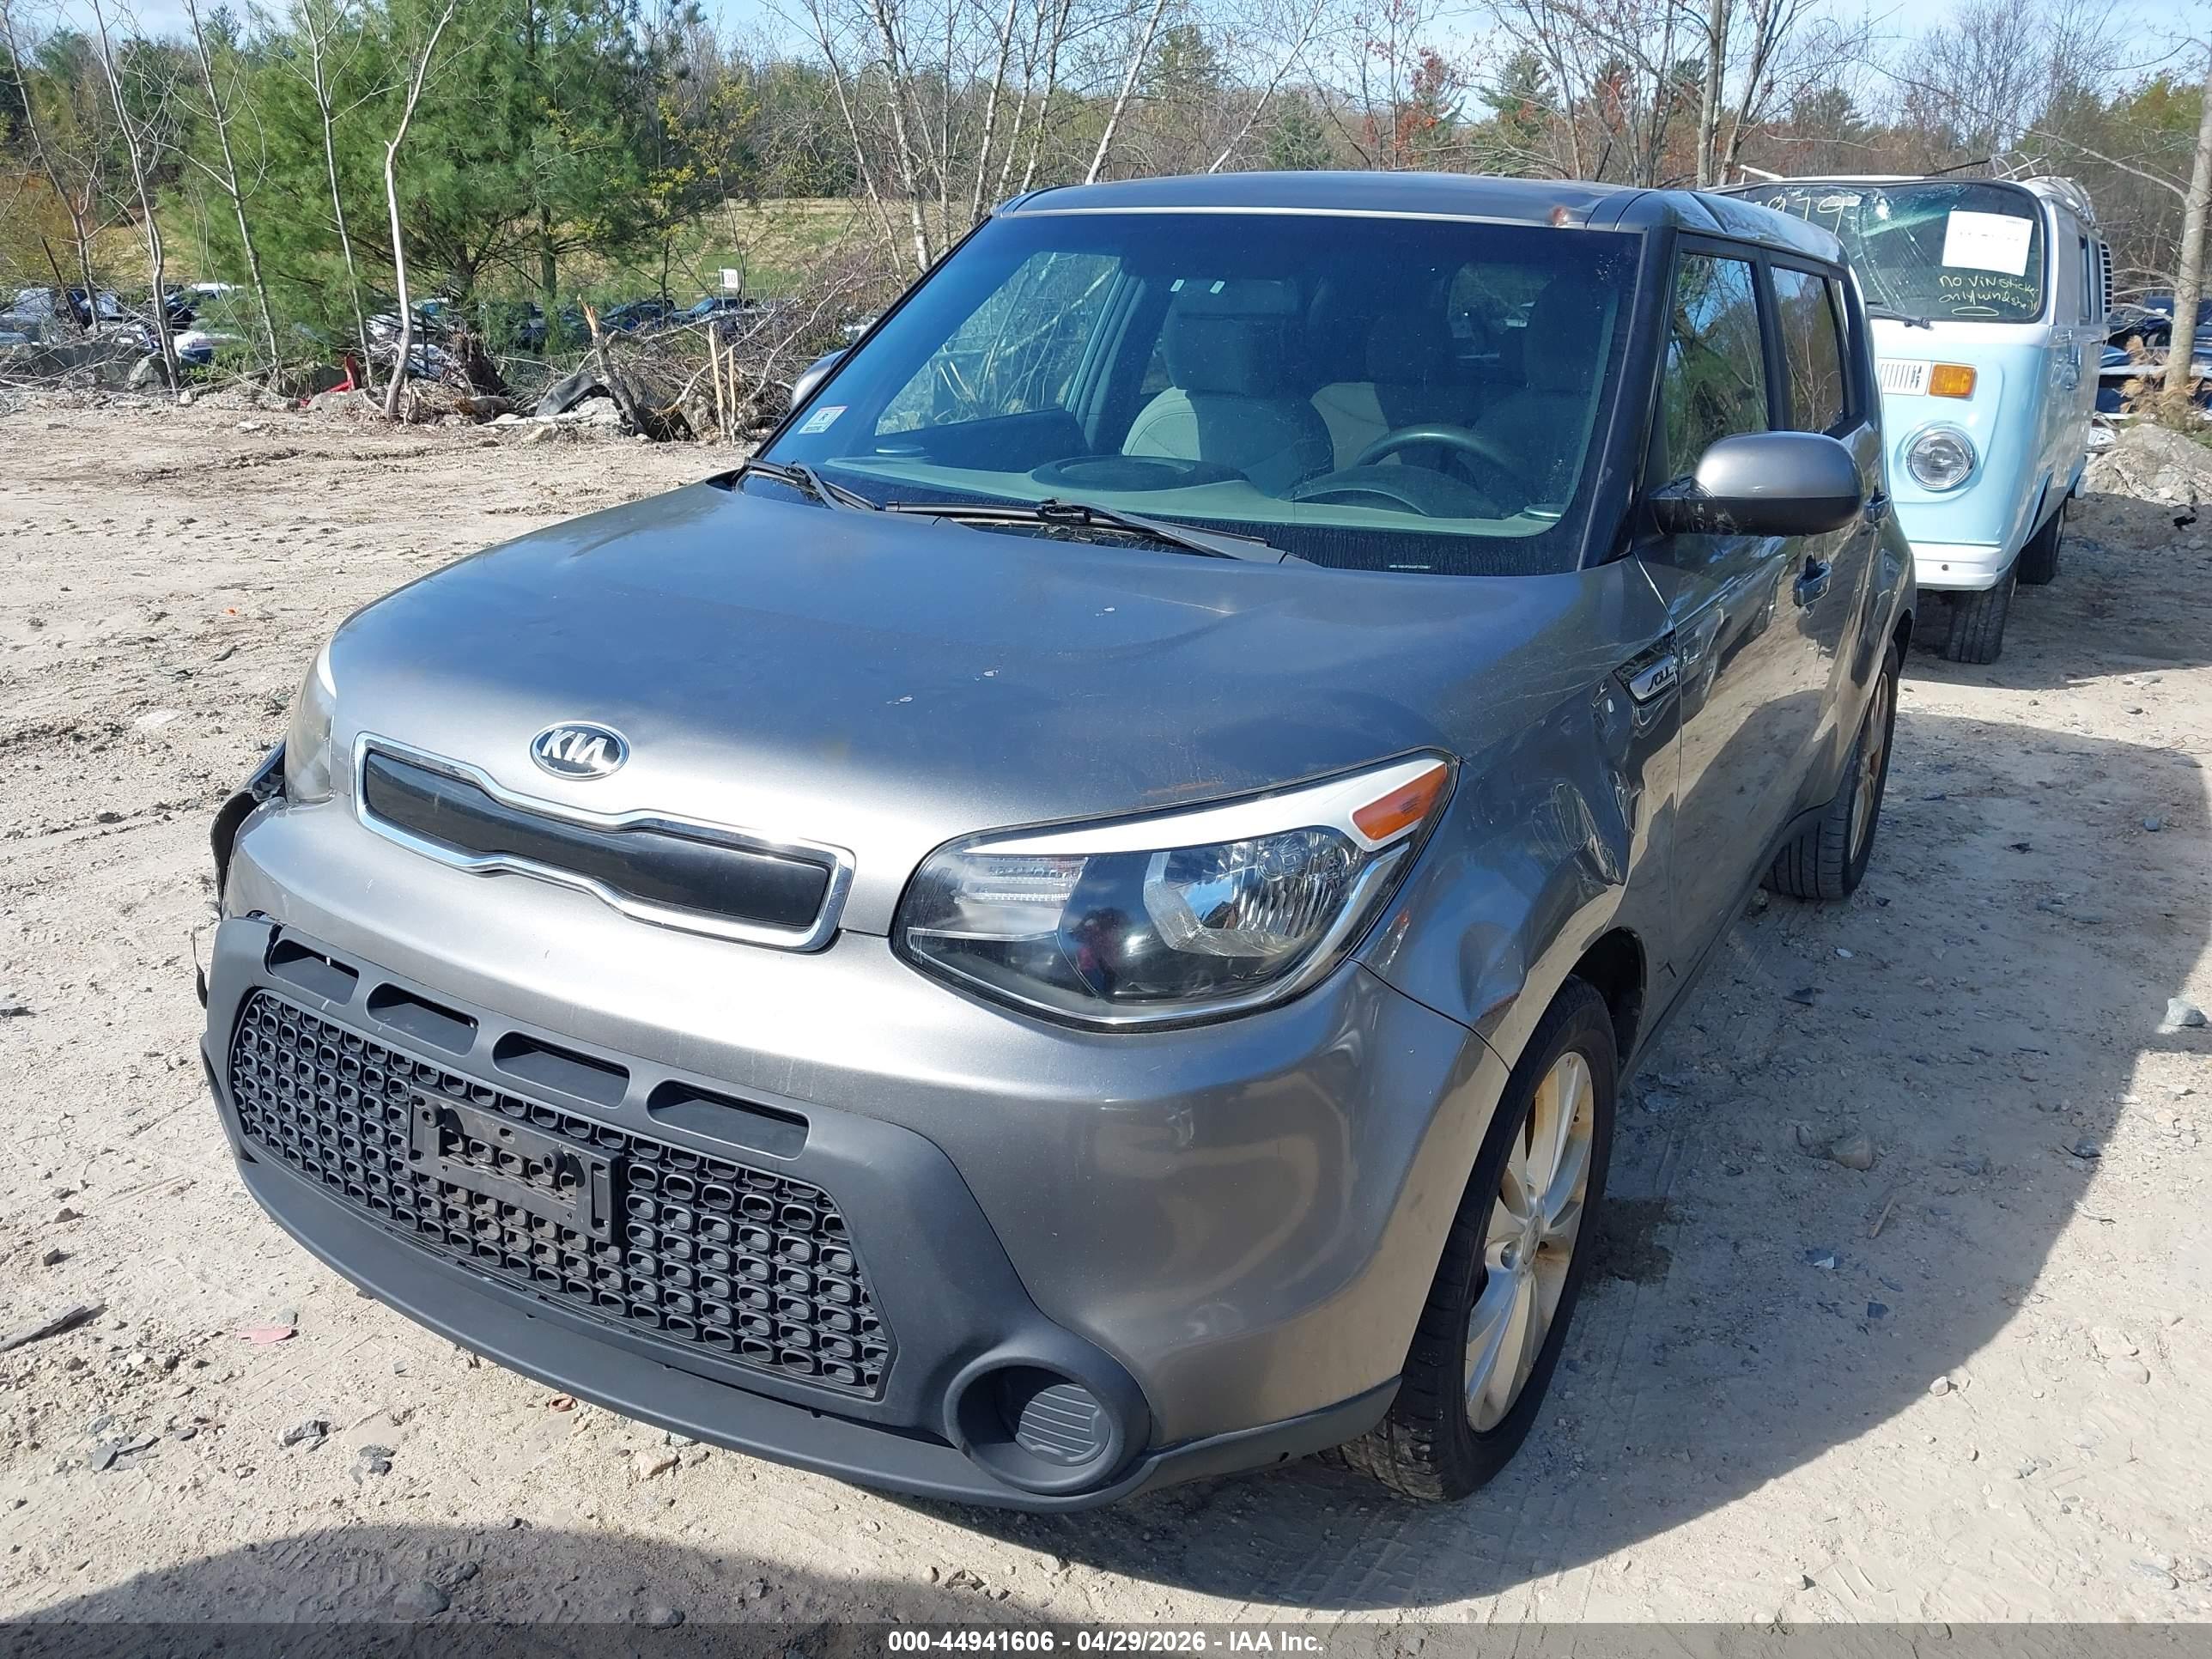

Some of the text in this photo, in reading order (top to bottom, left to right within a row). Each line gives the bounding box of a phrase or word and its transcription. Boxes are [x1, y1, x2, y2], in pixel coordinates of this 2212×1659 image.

[1754, 193, 1845, 235] 979
[725, 273, 737, 283] 30
[541, 729, 611, 770] KIA
